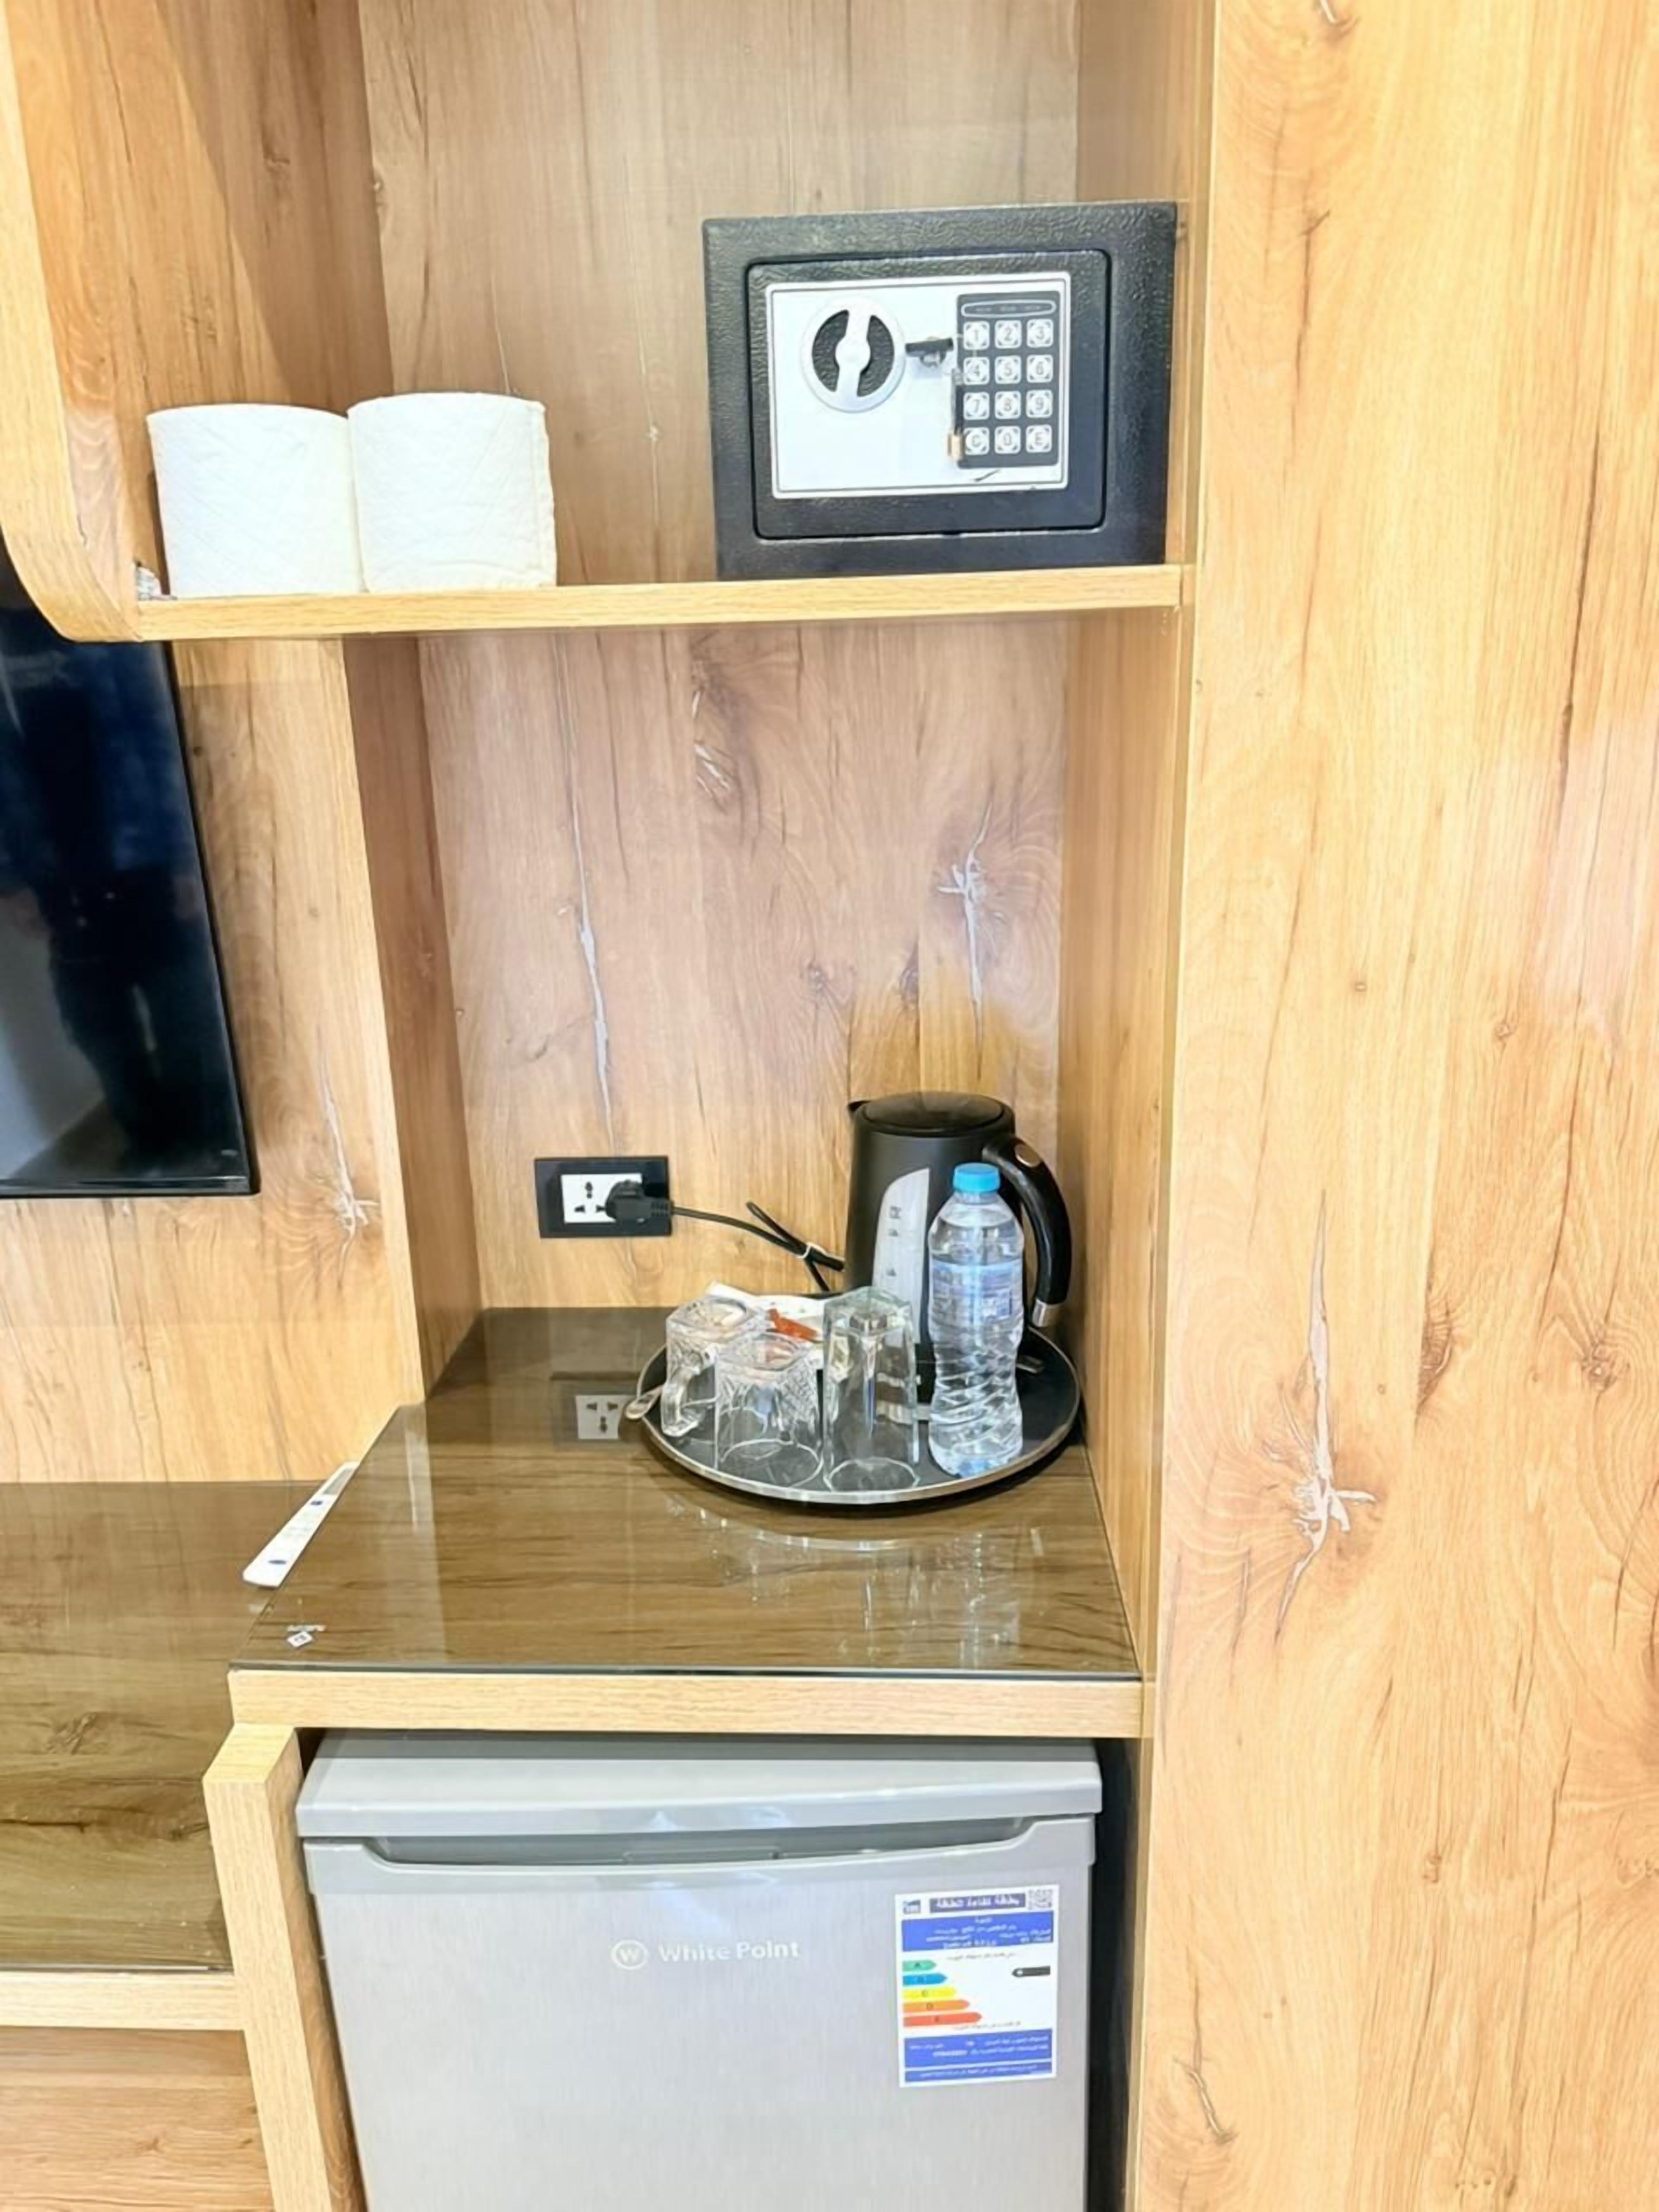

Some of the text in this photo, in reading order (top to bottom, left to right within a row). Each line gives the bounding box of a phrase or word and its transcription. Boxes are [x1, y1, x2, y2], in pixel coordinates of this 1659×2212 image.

[1004, 327, 1013, 341] 2
[1036, 326, 1045, 340] 3
[1004, 362, 1013, 377] 5
[1036, 361, 1044, 375] 6
[972, 397, 1044, 413] 7 8 9
[971, 434, 982, 448] C
[658, 1940, 800, 1962] White Point
